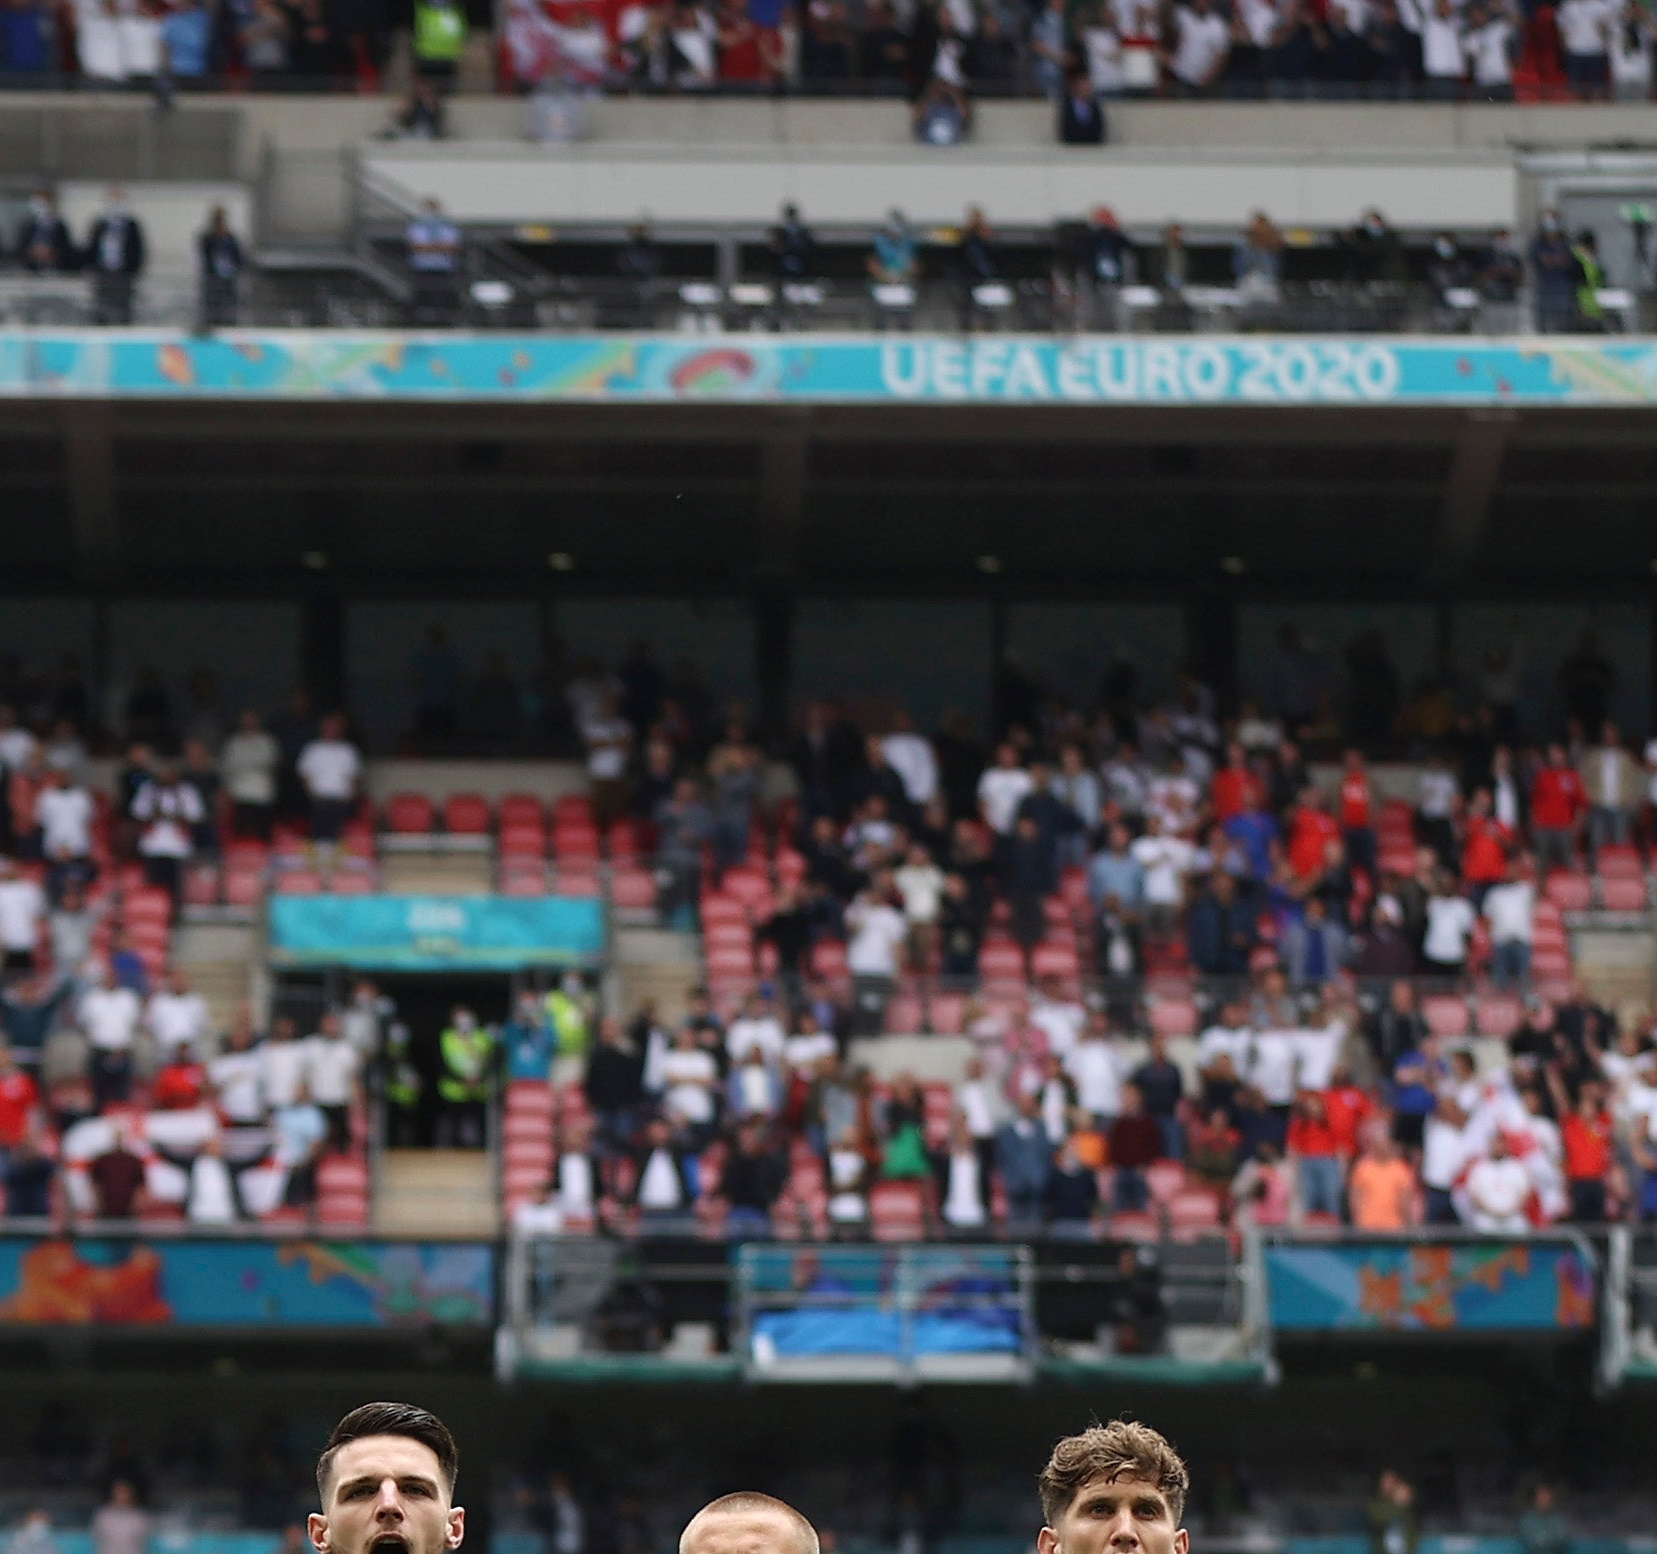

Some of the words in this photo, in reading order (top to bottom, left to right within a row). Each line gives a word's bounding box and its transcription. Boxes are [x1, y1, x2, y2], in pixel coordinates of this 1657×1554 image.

[880, 342, 1044, 400] UEFA
[1056, 342, 1229, 400] EURO
[1240, 342, 1401, 400] 2020
